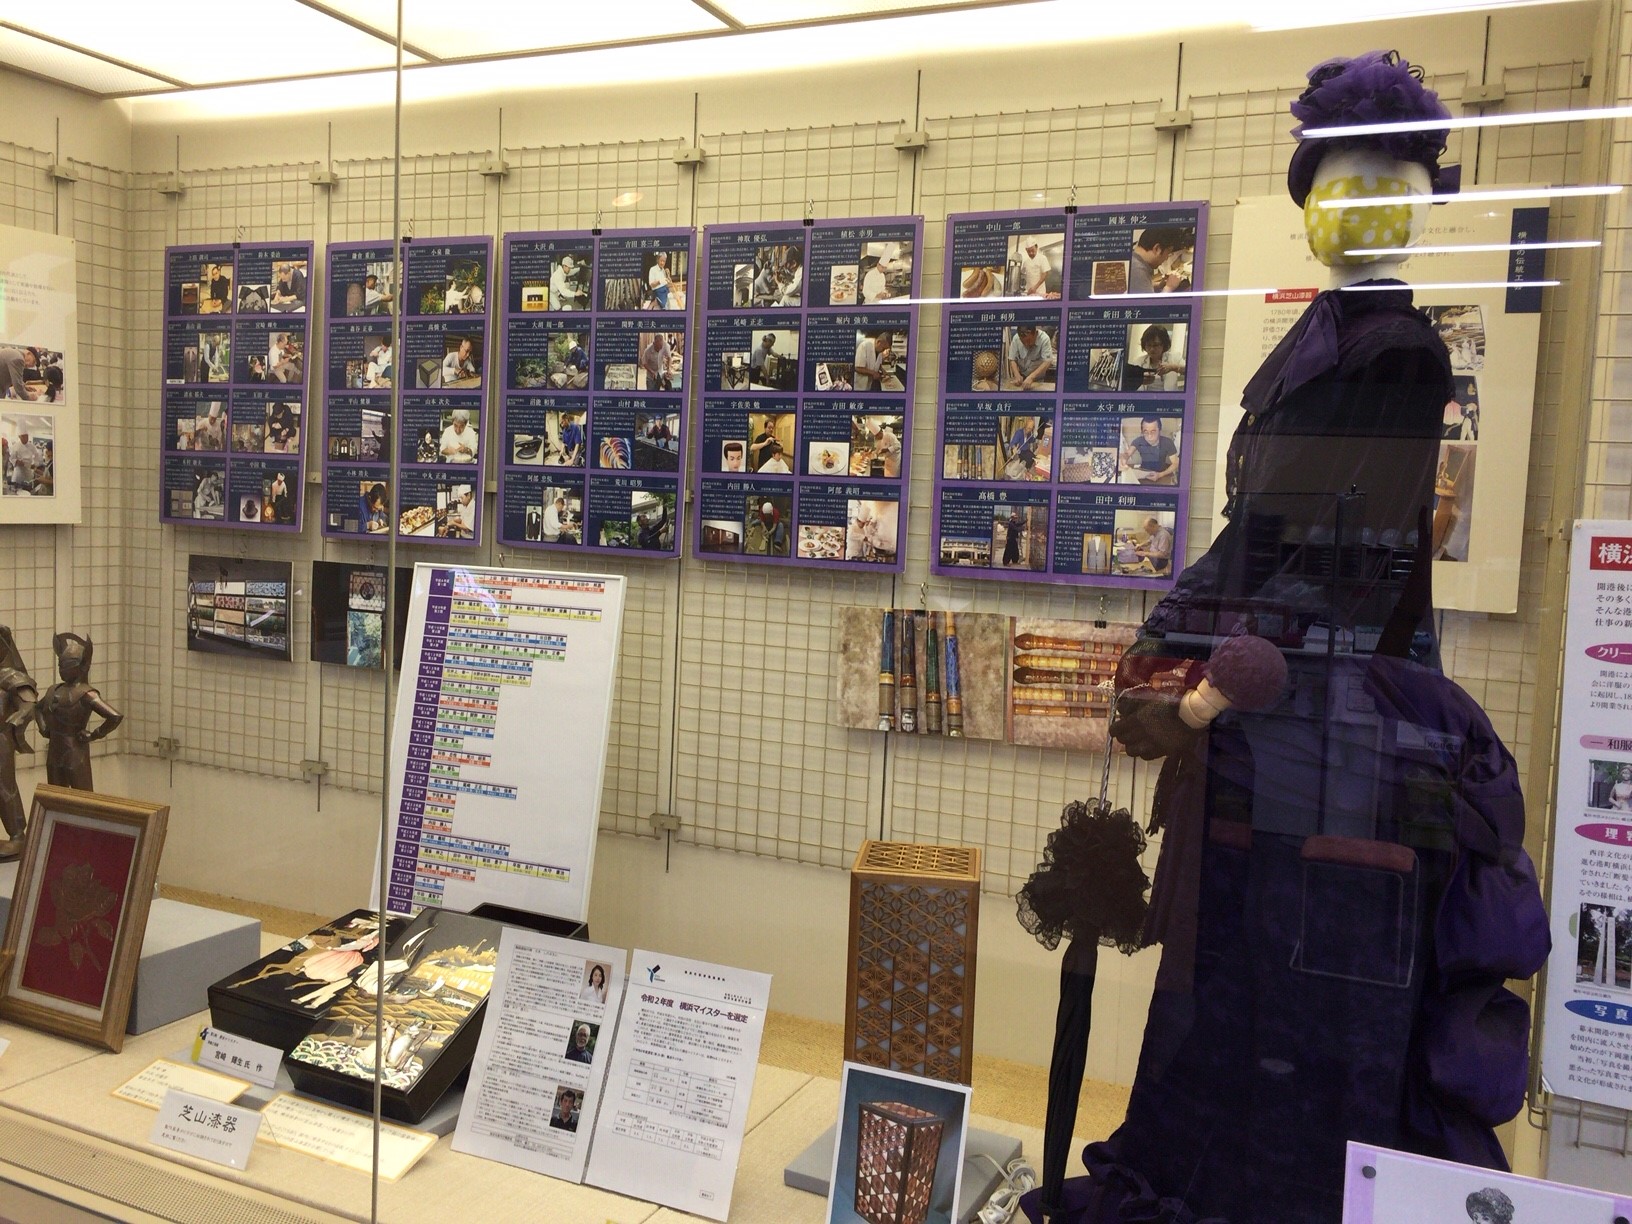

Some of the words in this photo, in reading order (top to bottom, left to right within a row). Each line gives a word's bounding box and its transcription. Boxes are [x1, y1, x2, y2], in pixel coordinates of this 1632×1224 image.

[985, 223, 1002, 231] 中山
[624, 240, 638, 248] 吉田
[981, 313, 996, 322] 田中
[1103, 311, 1120, 319] 新田
[831, 401, 847, 410] 吉田
[1094, 495, 1114, 505] 田中
[1117, 495, 1136, 506] 利明
[679, 1001, 749, 1024] 横浜マイスターを選定
[178, 1104, 238, 1133] 芝山漆器
